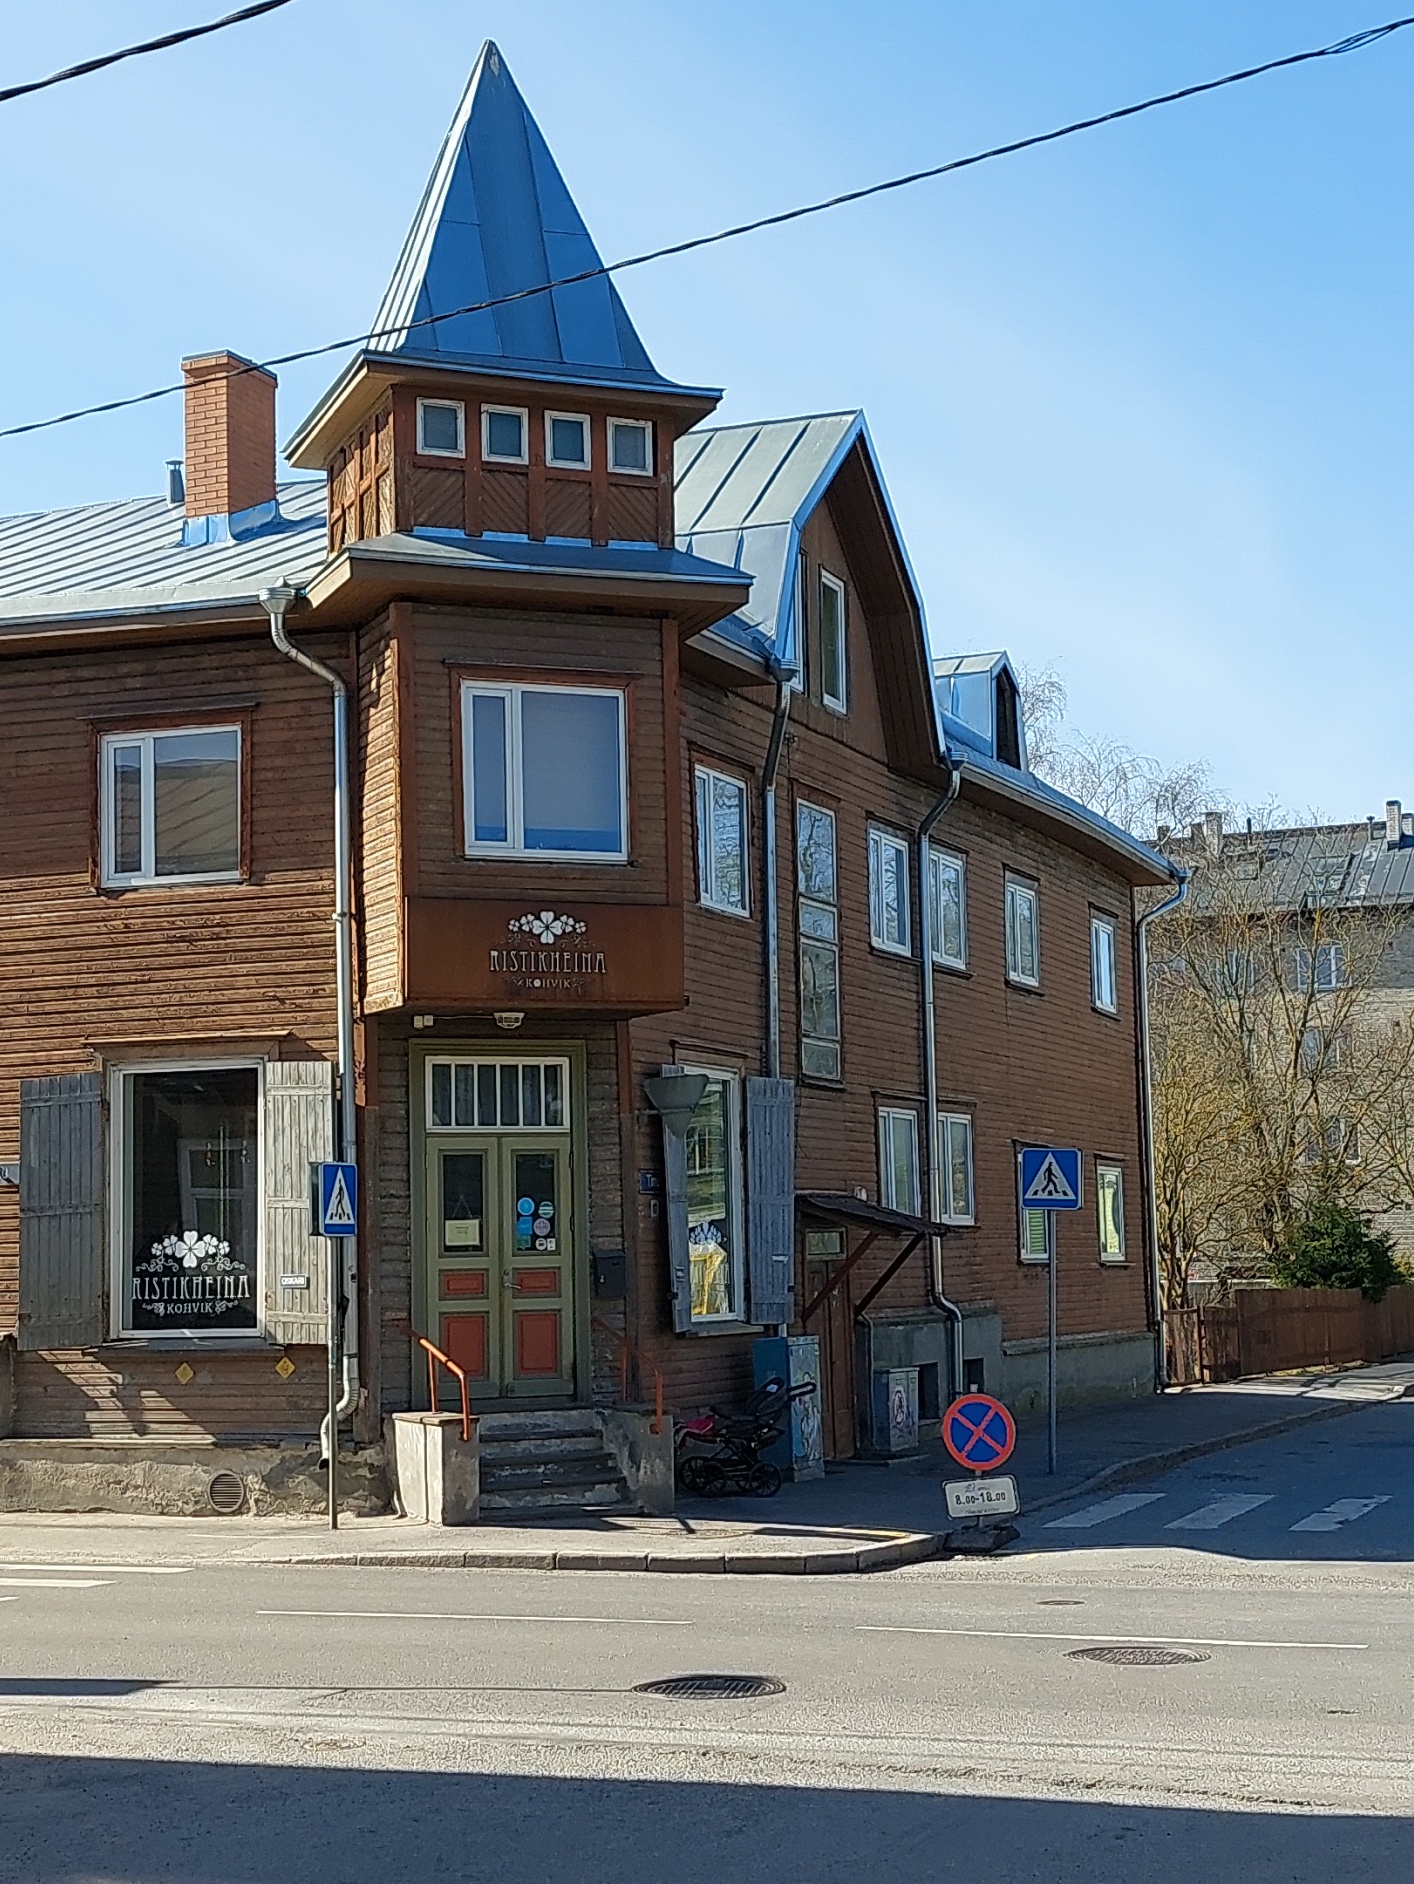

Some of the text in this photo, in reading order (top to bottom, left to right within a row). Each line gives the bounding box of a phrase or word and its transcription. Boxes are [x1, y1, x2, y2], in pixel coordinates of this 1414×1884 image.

[489, 950, 607, 974] RISTIKHEINA
[525, 978, 571, 988] KOHVIK
[132, 1275, 251, 1300] RISTIKHEINA
[166, 1302, 214, 1314] KOHVIK
[955, 1491, 1007, 1505] 8.00-18.00
